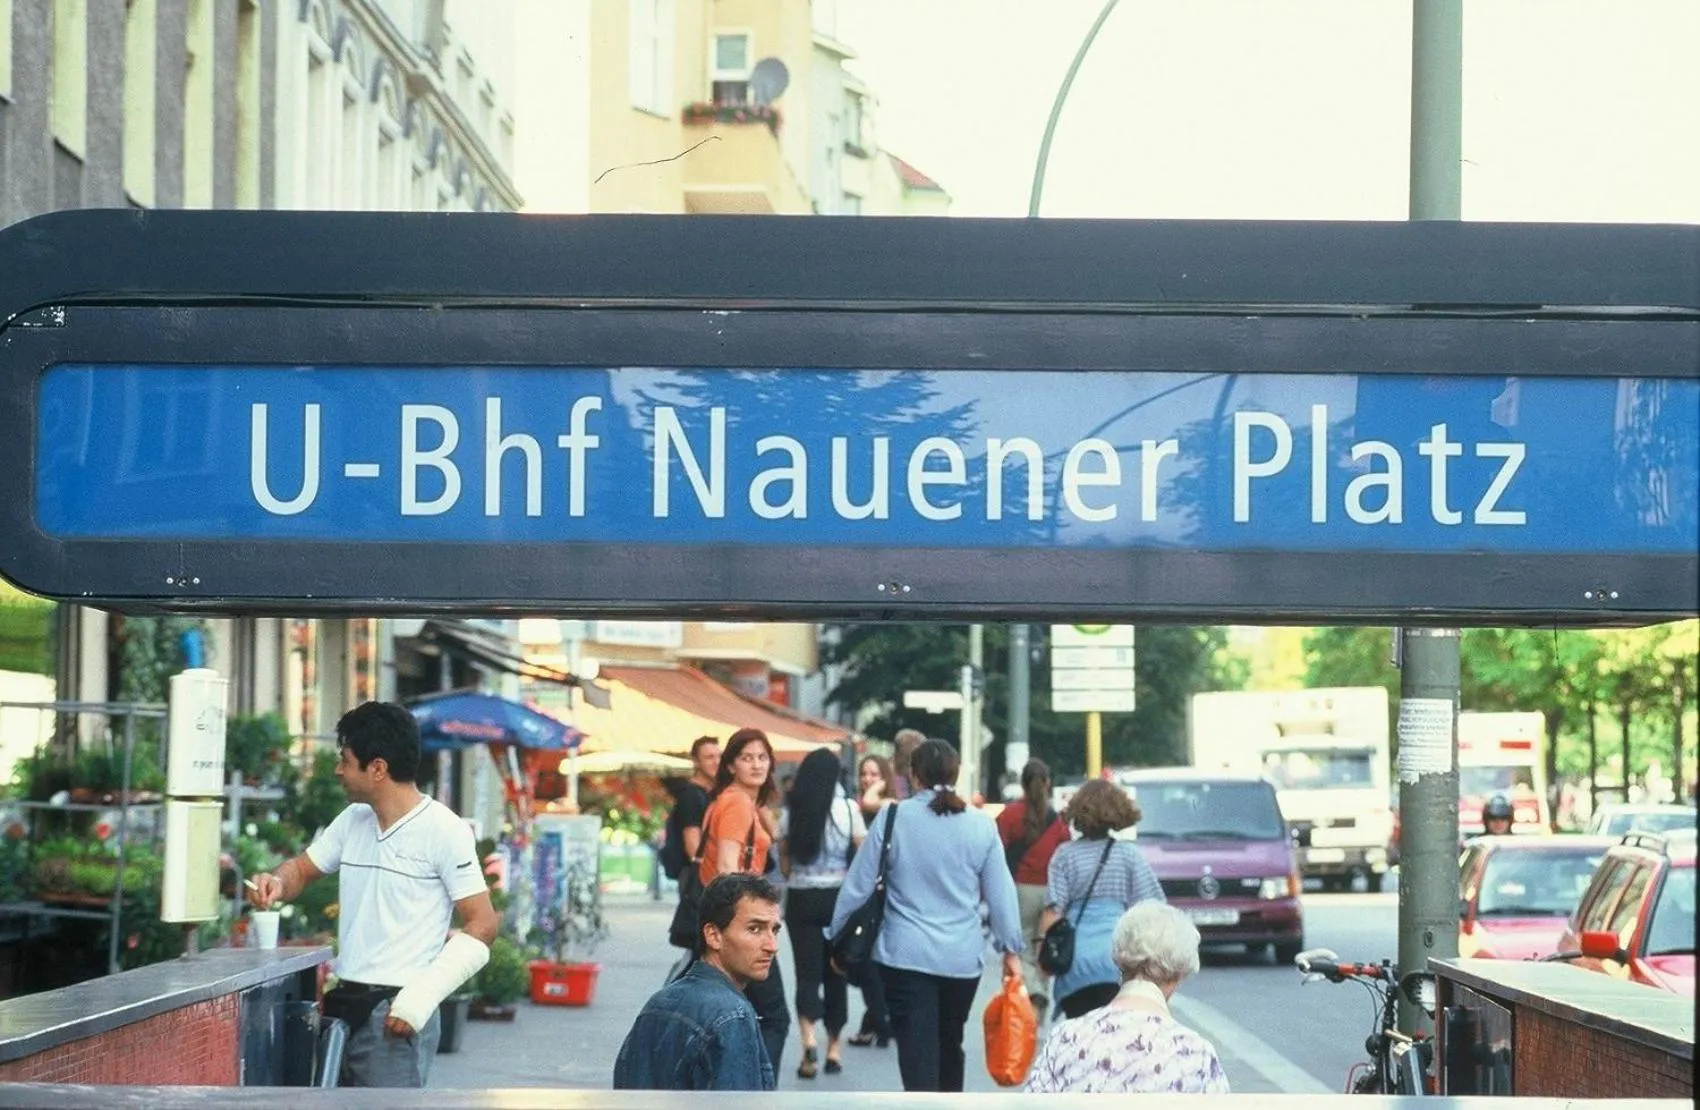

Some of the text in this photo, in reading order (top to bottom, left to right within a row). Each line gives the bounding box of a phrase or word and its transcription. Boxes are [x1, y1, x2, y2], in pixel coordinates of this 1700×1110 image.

[250, 396, 1528, 526] U-Bhf Nauener Platz
